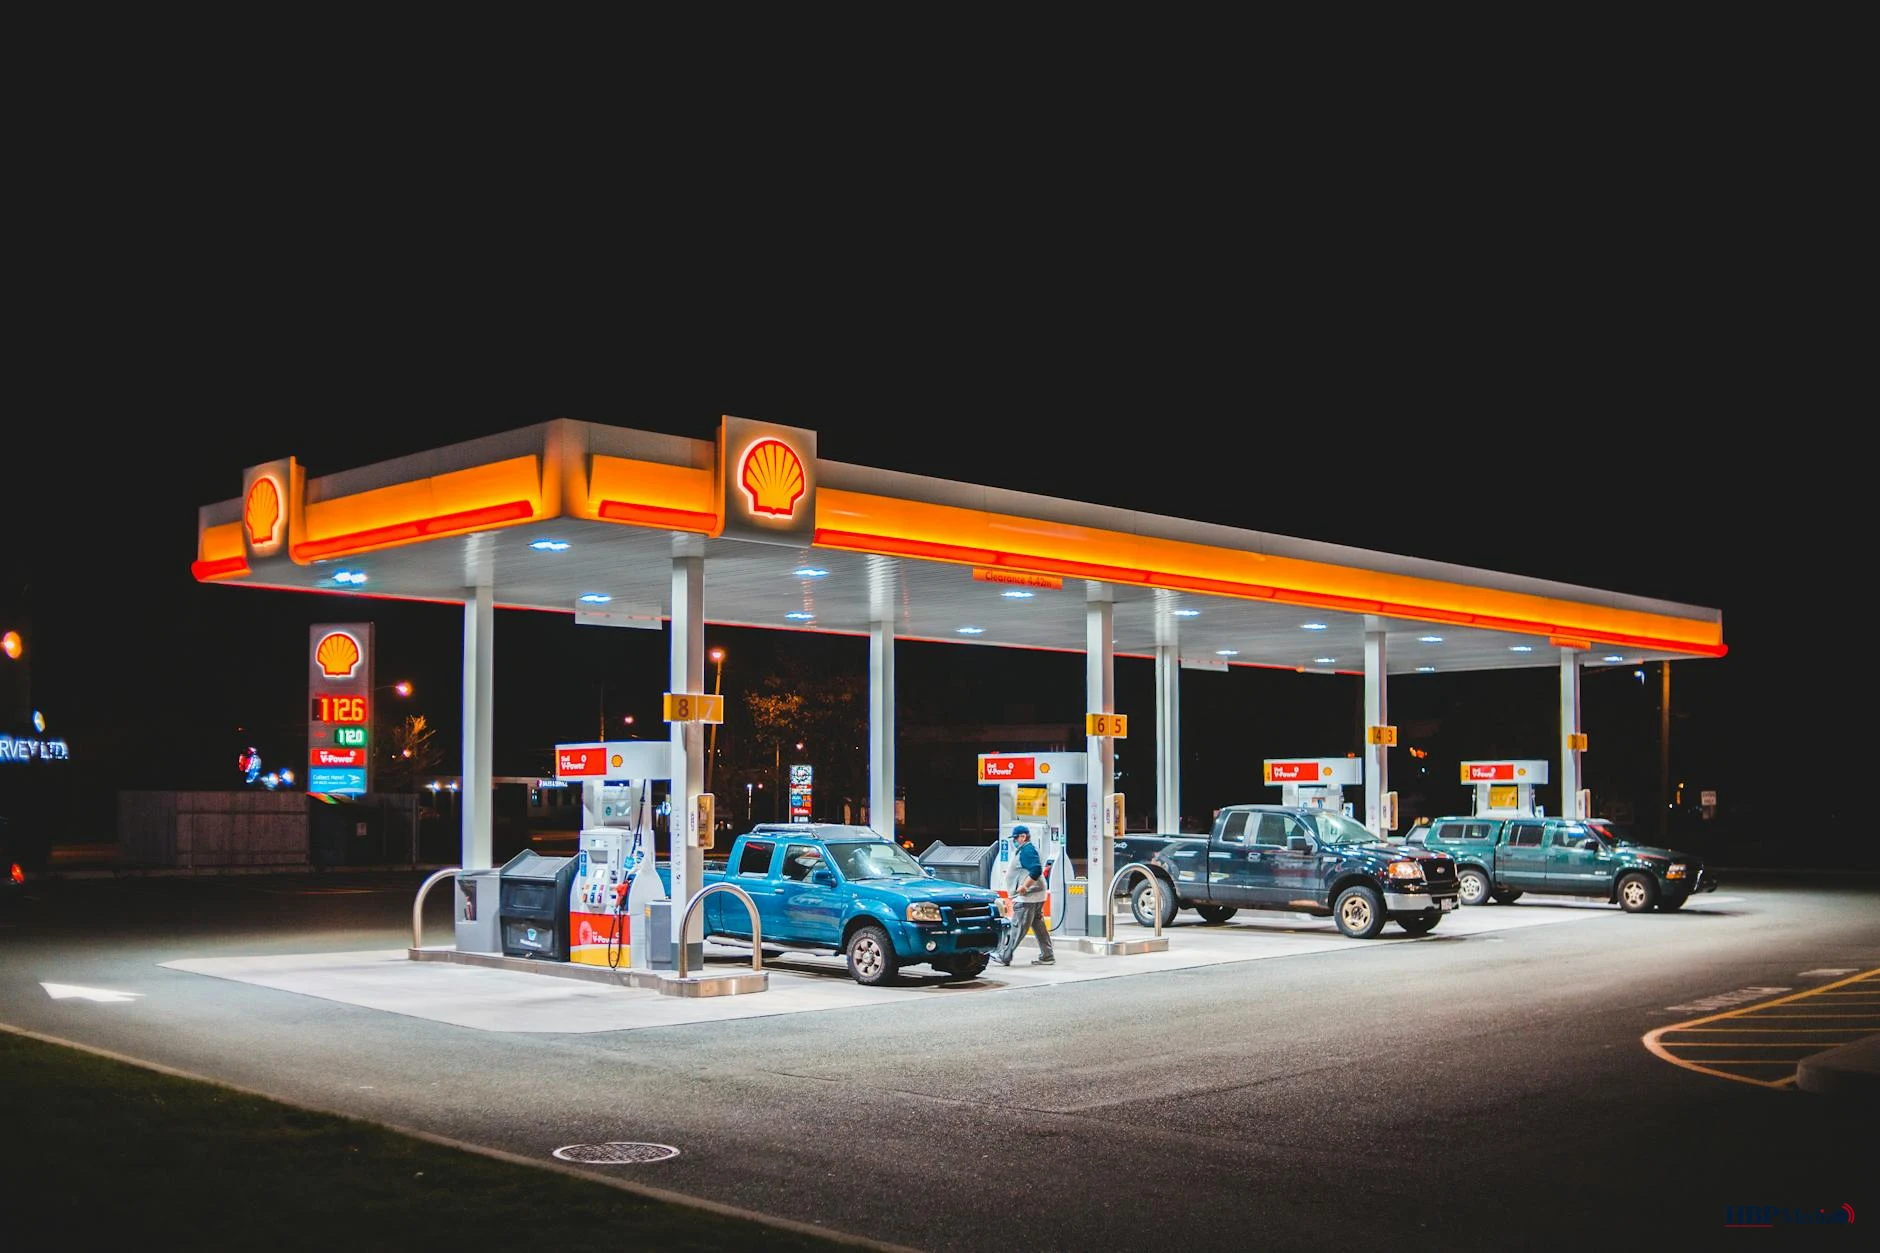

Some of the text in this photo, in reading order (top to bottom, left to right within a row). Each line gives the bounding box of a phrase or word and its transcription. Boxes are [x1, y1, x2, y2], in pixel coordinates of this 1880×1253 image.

[985, 569, 1025, 584] Clearance
[678, 698, 715, 720] 8 7
[1097, 717, 1122, 734] 6 5
[1375, 729, 1393, 743] 4 3
[0, 740, 69, 760] RVEY LTD.
[320, 755, 355, 764] V-Power
[561, 762, 585, 770] V-Power
